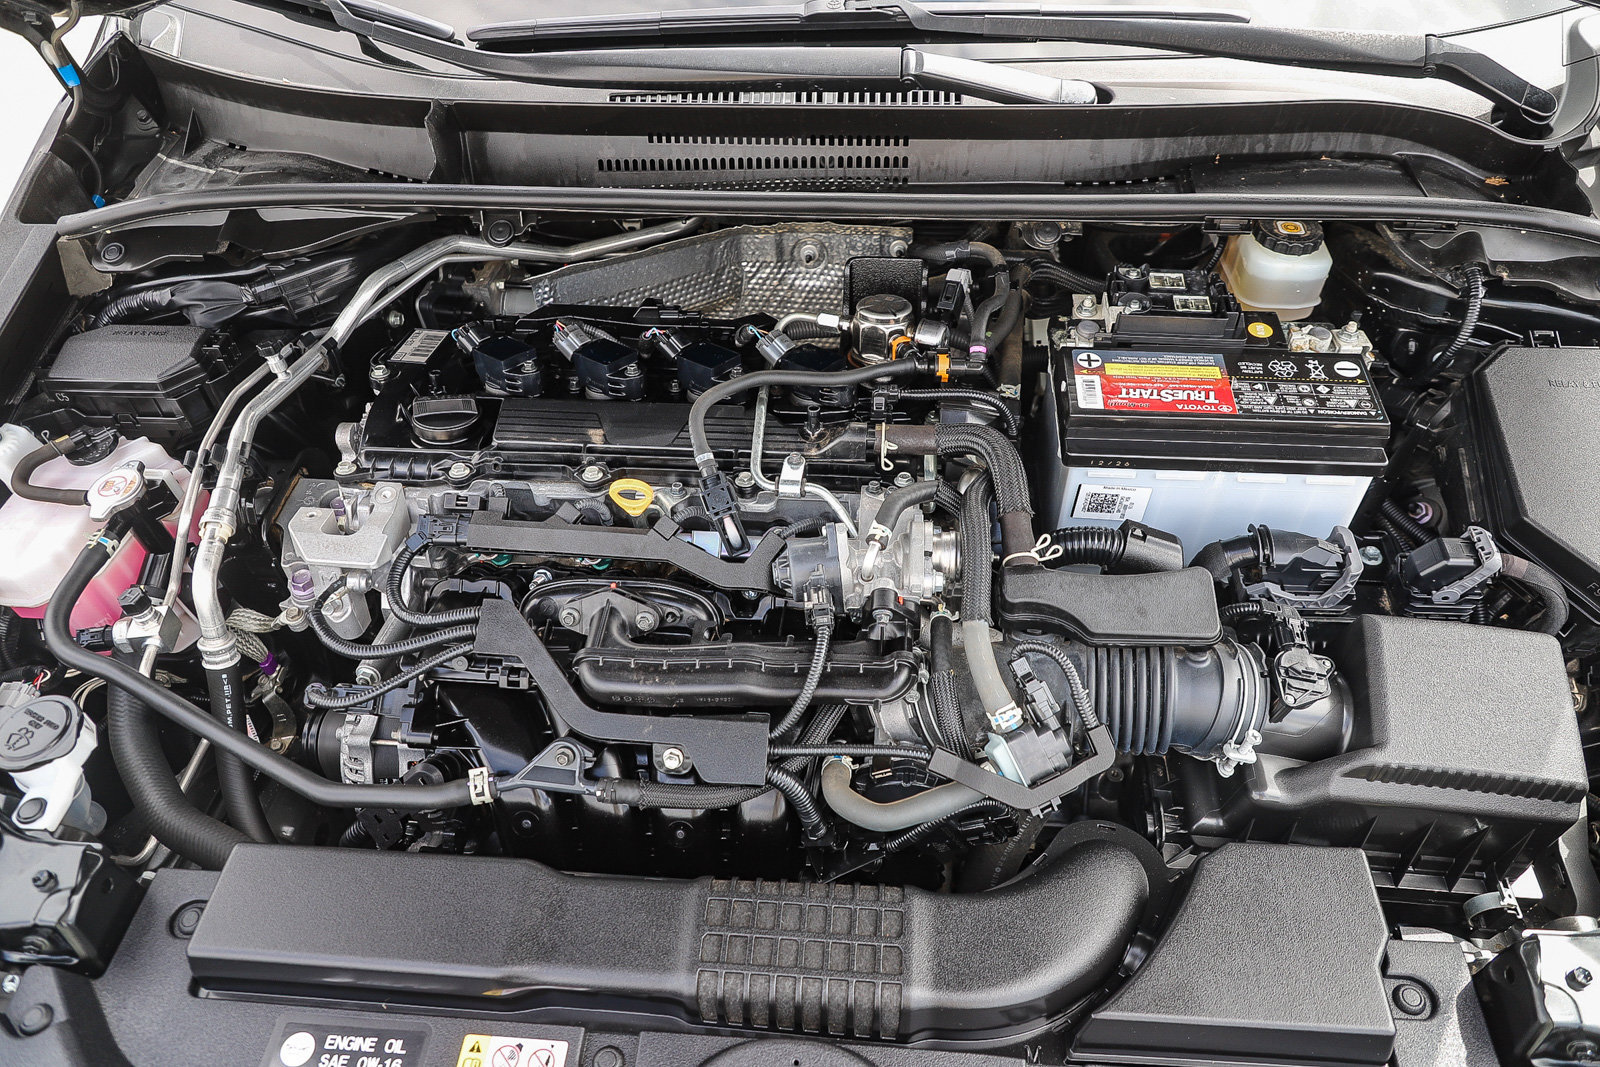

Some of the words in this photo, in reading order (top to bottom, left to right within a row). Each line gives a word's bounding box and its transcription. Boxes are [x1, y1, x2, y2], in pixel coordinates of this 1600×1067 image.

[1176, 403, 1216, 411] TOYOTA
[324, 1034, 378, 1052] ENGINE
[384, 1038, 407, 1055] OIL
[318, 1053, 350, 1067] SAE
